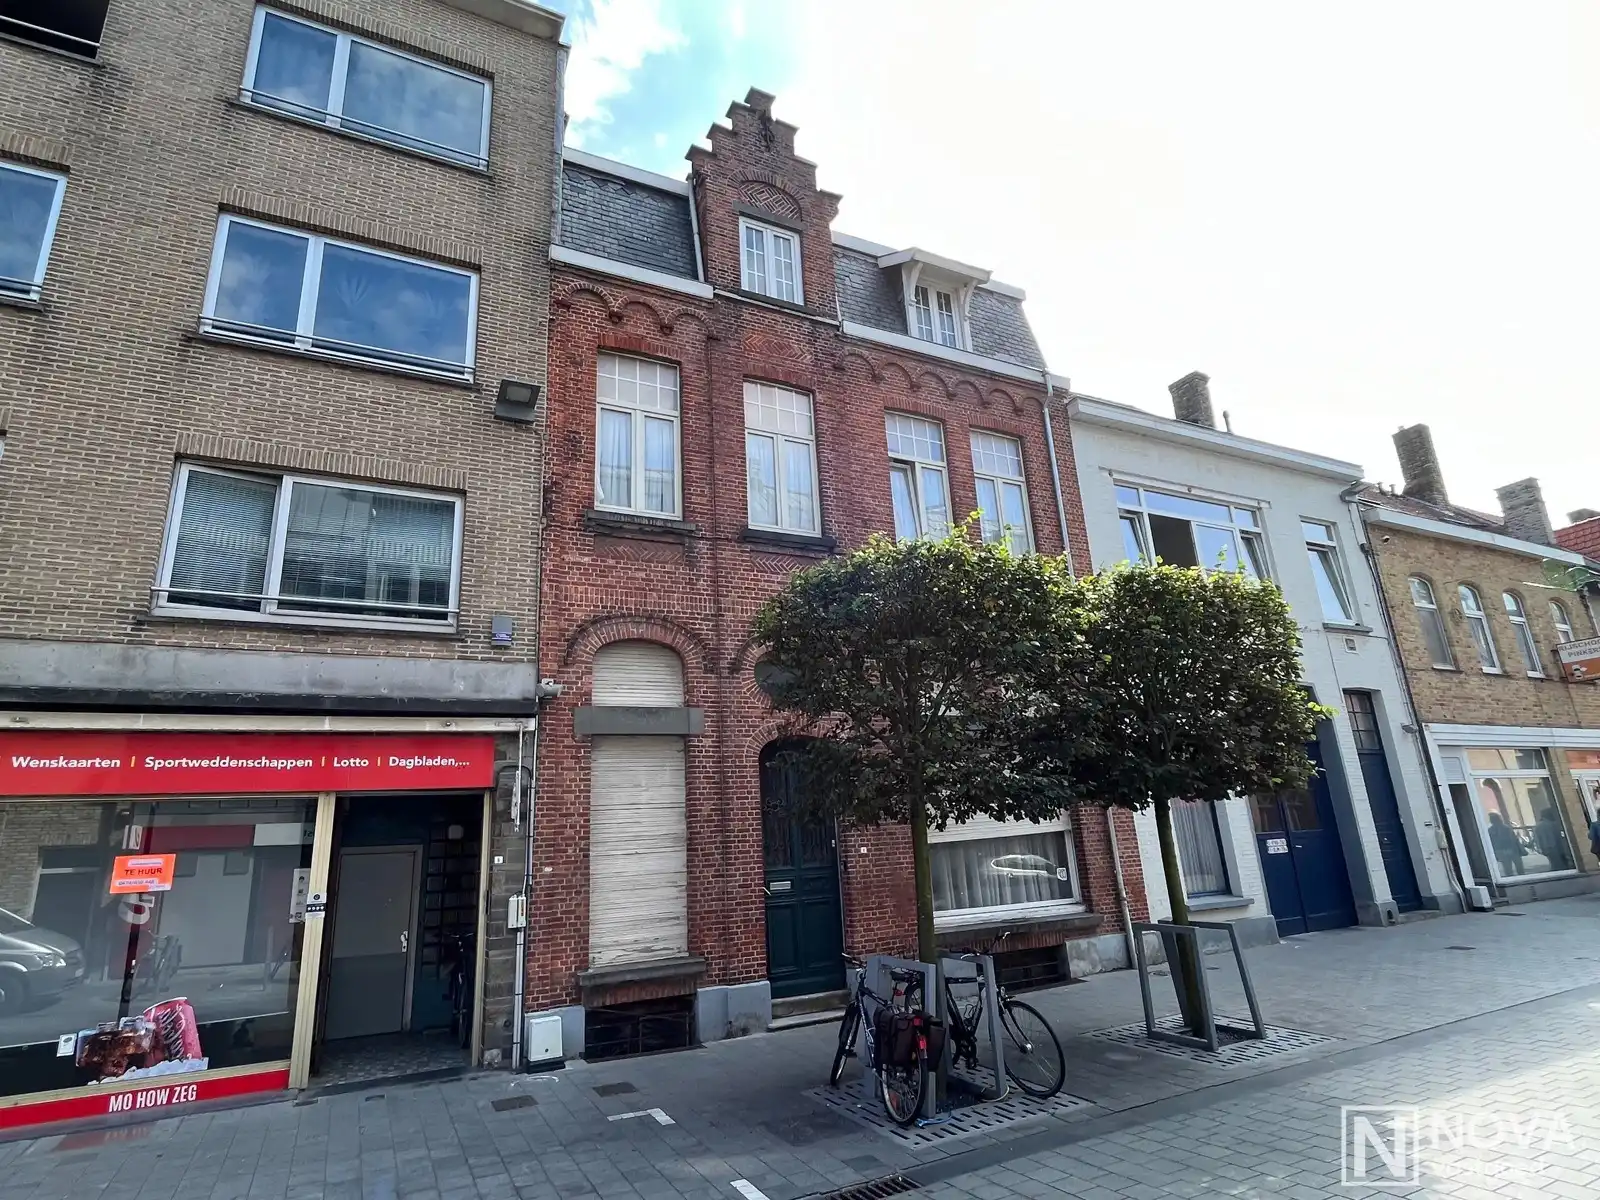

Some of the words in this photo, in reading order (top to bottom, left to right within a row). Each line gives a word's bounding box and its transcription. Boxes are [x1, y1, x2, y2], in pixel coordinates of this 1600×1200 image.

[12, 756, 121, 768] Wenskaarten
[144, 756, 313, 771] Sportweddenschappen
[333, 756, 369, 768] Lotto
[388, 755, 470, 770] Dagbladen,...
[124, 868, 134, 876] TE
[138, 867, 163, 876] HUUR
[109, 1093, 133, 1113] MO
[136, 1087, 170, 1109] HOW
[172, 1084, 198, 1104] ZEG
